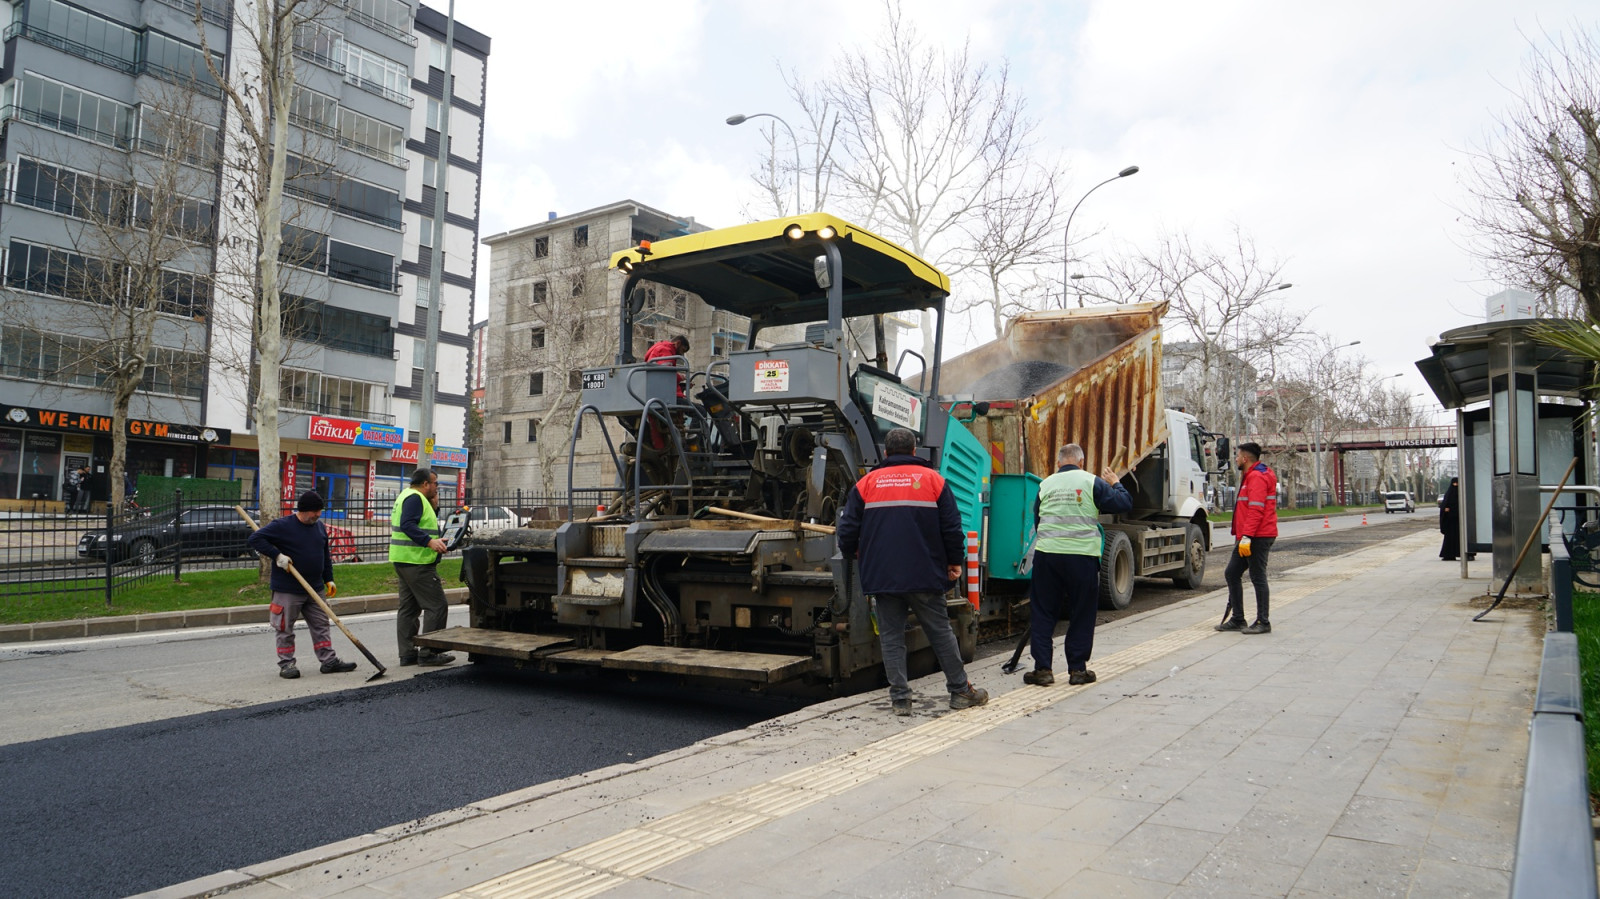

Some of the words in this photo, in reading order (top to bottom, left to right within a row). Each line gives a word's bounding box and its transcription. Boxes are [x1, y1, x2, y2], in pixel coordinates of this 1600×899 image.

[38, 410, 111, 432] WE-KIN
[130, 420, 168, 437] GYM
[362, 429, 401, 444] YATAK-BAZA
[430, 451, 466, 463] ATAK-BAZA
